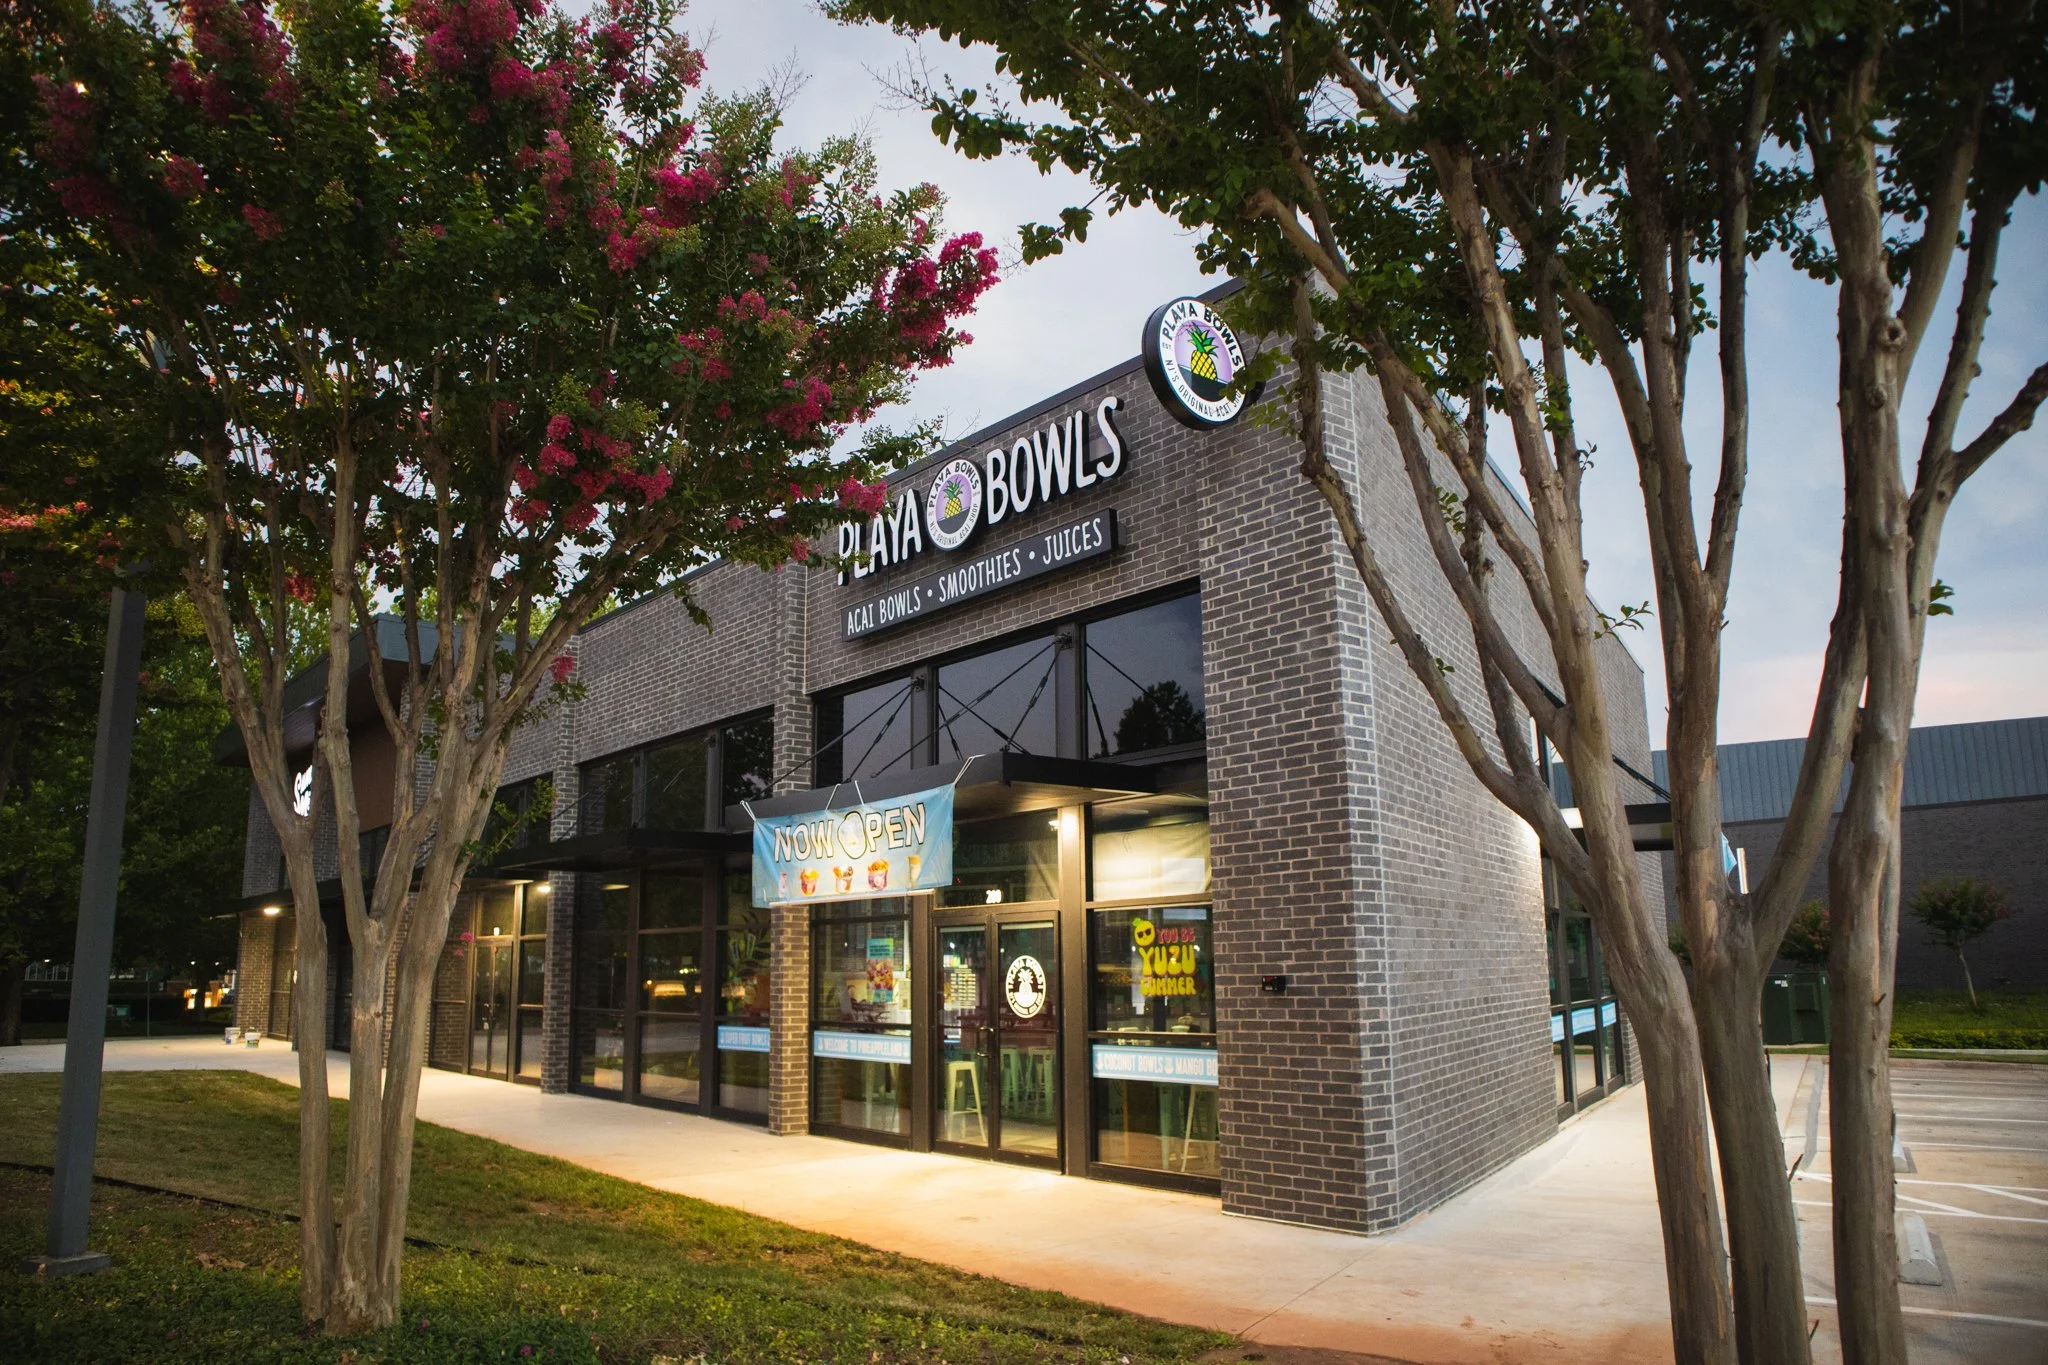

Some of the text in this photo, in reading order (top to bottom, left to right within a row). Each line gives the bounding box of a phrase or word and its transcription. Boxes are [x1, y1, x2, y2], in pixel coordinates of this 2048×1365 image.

[1162, 302, 1242, 367] PLAYA BOWLS
[1165, 359, 1180, 382] NJ'S
[1178, 384, 1214, 417] ORIGINAL
[837, 396, 1124, 586] PLAYA BOWLS
[928, 462, 979, 508] PLAYA BOWLS
[969, 503, 979, 523] SHOP
[847, 518, 1103, 636] ACAI BOWLS SMOOTHIES JUICES
[774, 802, 926, 863] NOW OPEN
[1156, 927, 1178, 944] YOU
[1138, 944, 1197, 977] YUZU
[1140, 976, 1197, 997] SUMMER
[1104, 1053, 1137, 1071] COCONUT
[1139, 1055, 1163, 1074] BOWLS
[1175, 1057, 1204, 1076] MANGO
